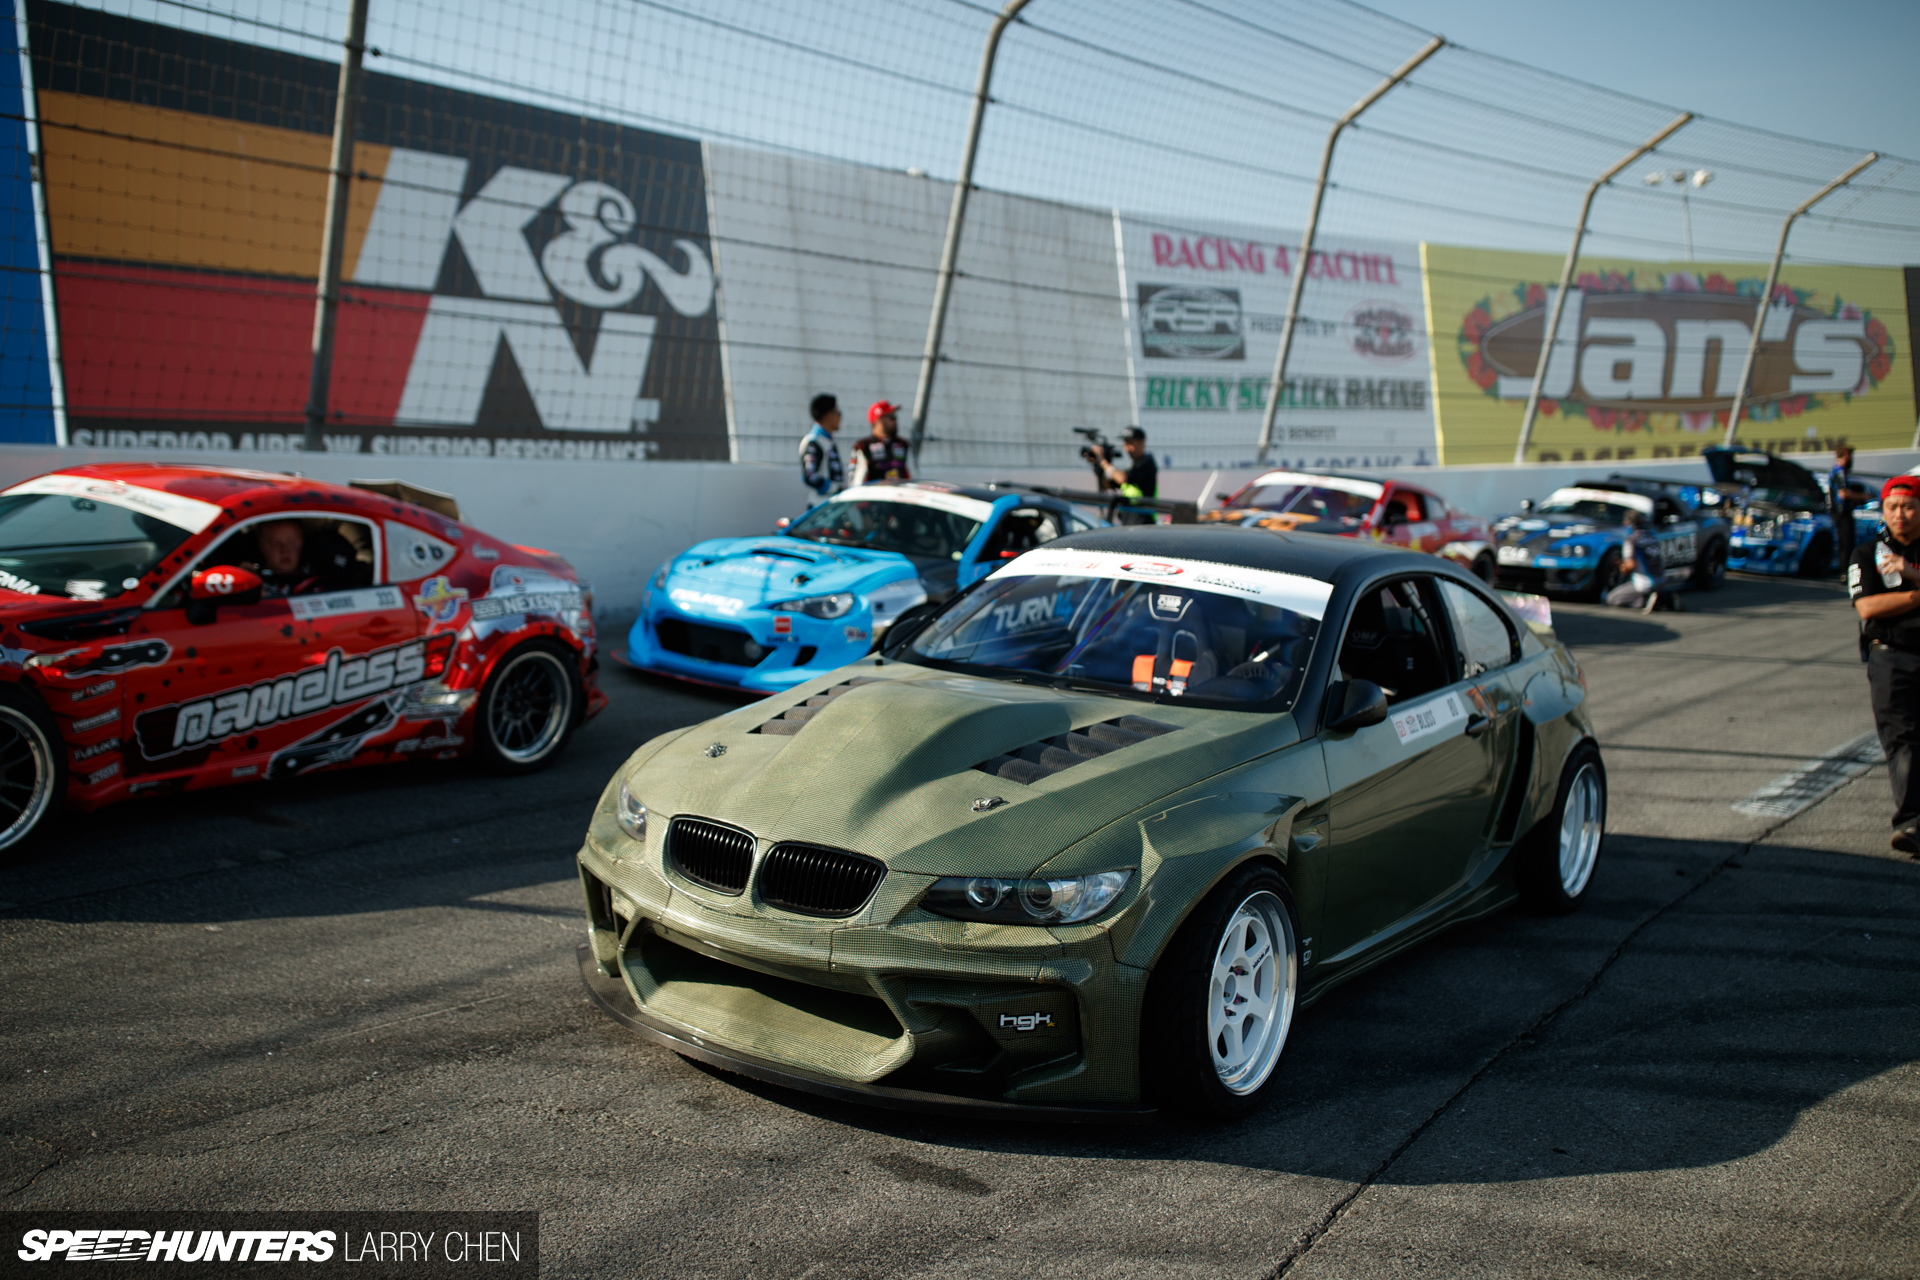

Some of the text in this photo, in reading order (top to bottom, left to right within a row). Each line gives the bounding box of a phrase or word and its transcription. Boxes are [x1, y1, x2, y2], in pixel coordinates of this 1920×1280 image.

[1152, 232, 1265, 275] RACING
[1274, 245, 1291, 276] 4
[1498, 287, 1866, 400] Jan's
[1145, 375, 1230, 410] RICKY
[1344, 379, 1426, 411] RACING
